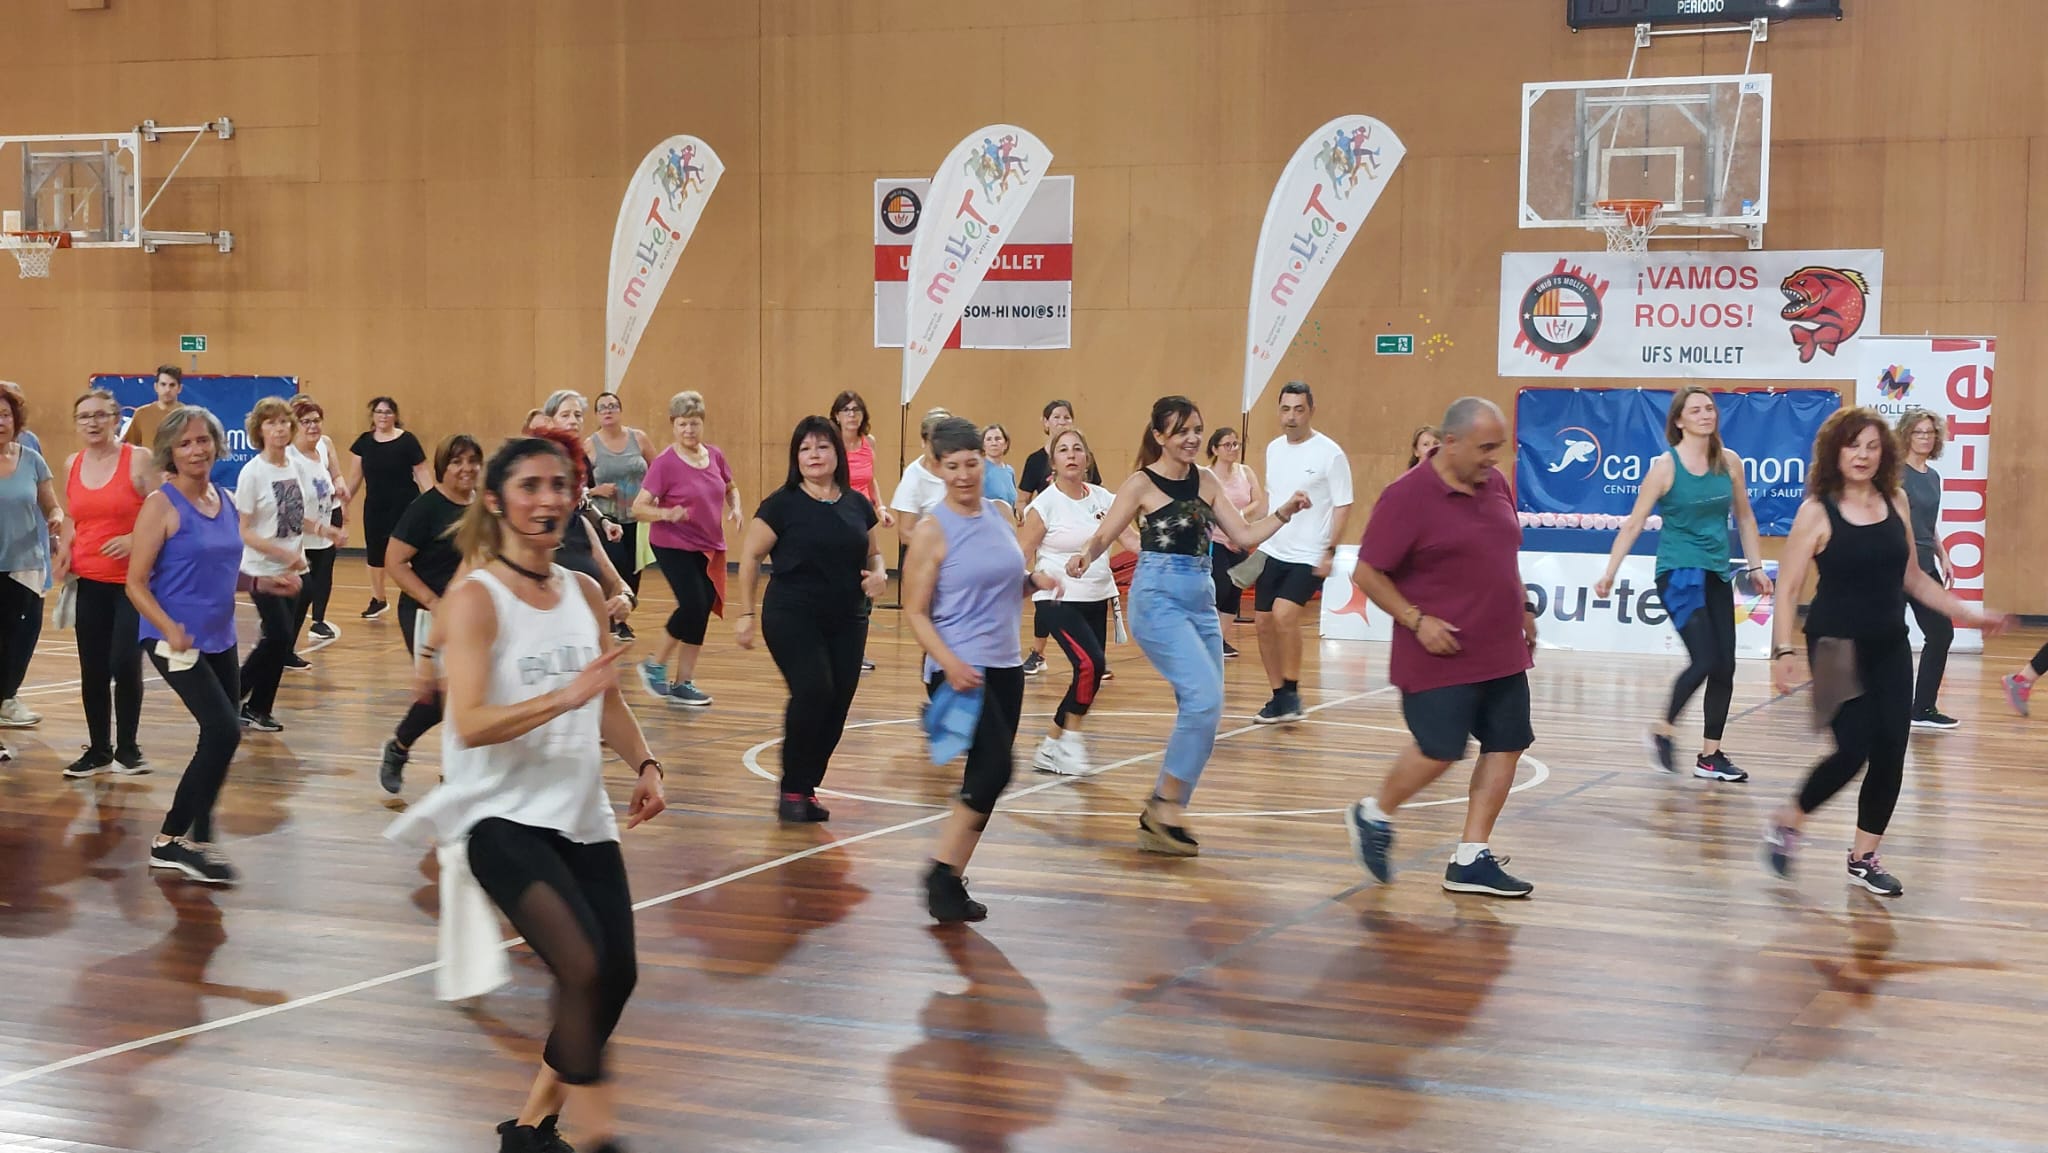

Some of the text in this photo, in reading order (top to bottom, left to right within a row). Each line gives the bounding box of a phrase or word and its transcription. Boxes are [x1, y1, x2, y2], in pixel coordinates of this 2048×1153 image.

[990, 254, 1045, 270] OLLET
[1637, 265, 1759, 296] ¡VAMOS
[964, 305, 1009, 318] SOM-HI
[1012, 304, 1054, 319] NOI@S
[1635, 303, 1754, 328] ROJOS!
[1642, 345, 1744, 364] UFS MOLLET
[1603, 455, 1641, 480] ca
[1770, 488, 1804, 498] SALUT
